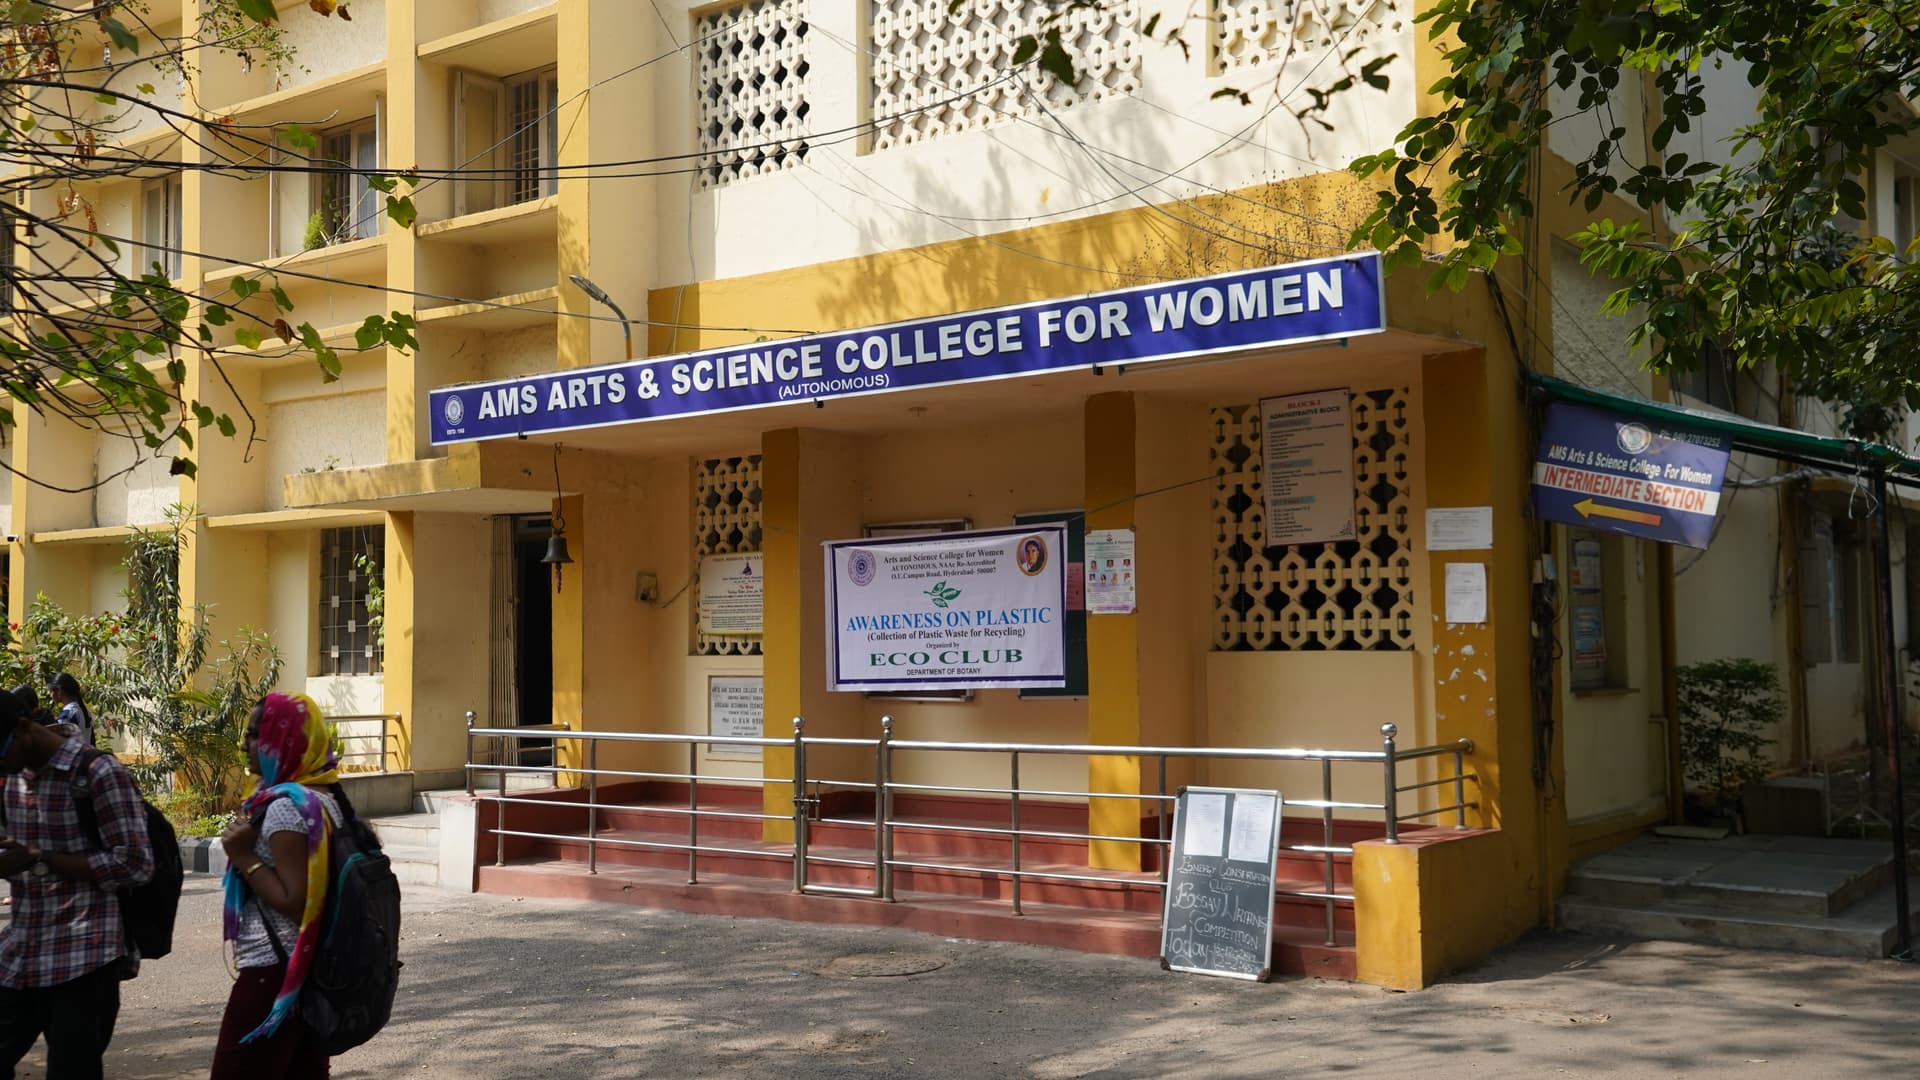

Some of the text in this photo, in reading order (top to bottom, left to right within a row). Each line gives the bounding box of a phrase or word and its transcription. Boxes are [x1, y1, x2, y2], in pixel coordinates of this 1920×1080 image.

[478, 268, 1343, 420] AMS ARTS & SCIENCE COLLEGE FOR WOMEN
[779, 373, 890, 400] (AUTONOMOUS)
[1548, 445, 1713, 485] AMS Arts & Science College For Women
[1543, 465, 1708, 511] INTERMEDIATE SECTION
[884, 549, 1004, 564] Arts and Science College for Women
[846, 607, 1052, 632] AWARENESS ON PLASTIC
[867, 627, 1026, 644] (Collection of Plastic Waste for Recycling)
[953, 641, 960, 650] by
[870, 648, 1024, 667] ECO CLUB
[906, 668, 982, 676] DEPARTMENT OF BOTANY
